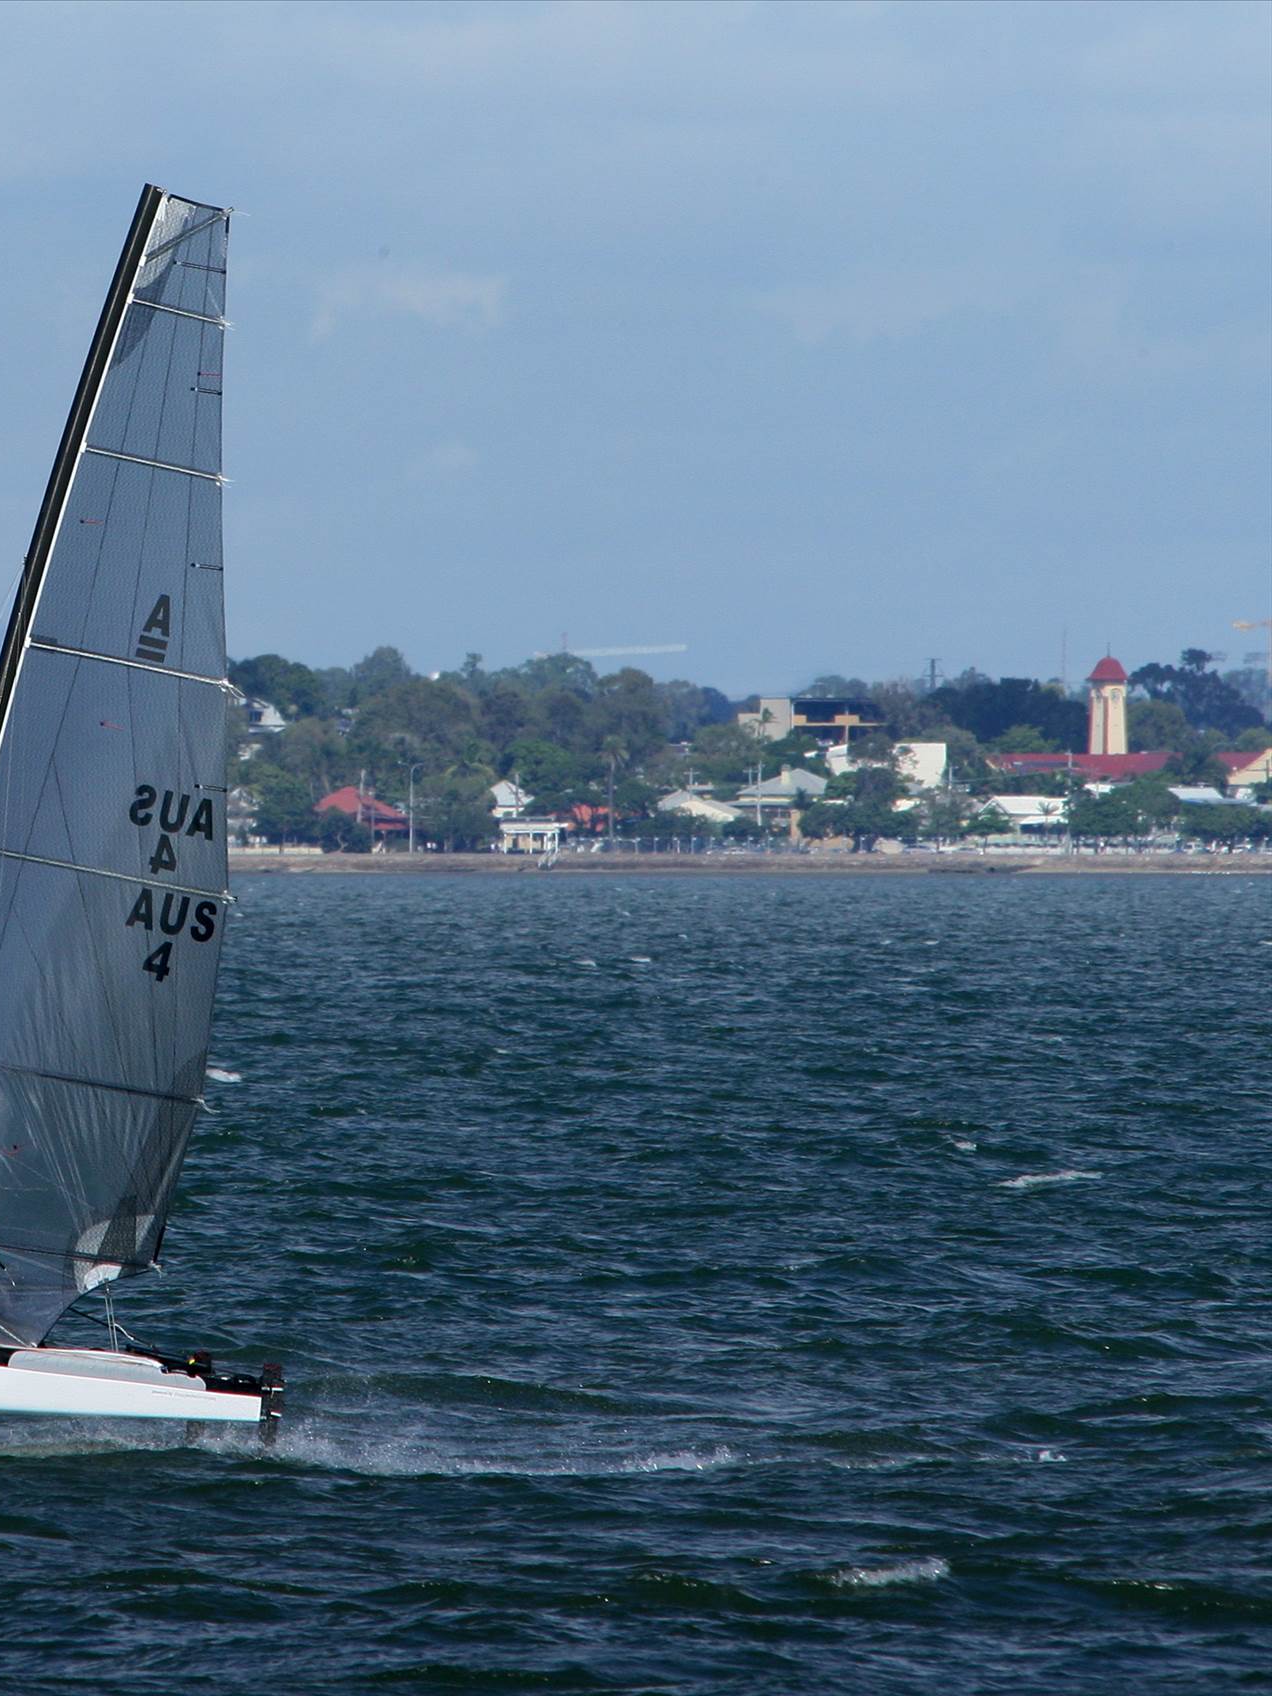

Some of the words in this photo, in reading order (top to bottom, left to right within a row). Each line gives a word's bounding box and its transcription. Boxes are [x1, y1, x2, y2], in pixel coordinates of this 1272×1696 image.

[142, 594, 170, 637] A
[125, 887, 217, 942] AUS
[142, 941, 173, 982] 4
